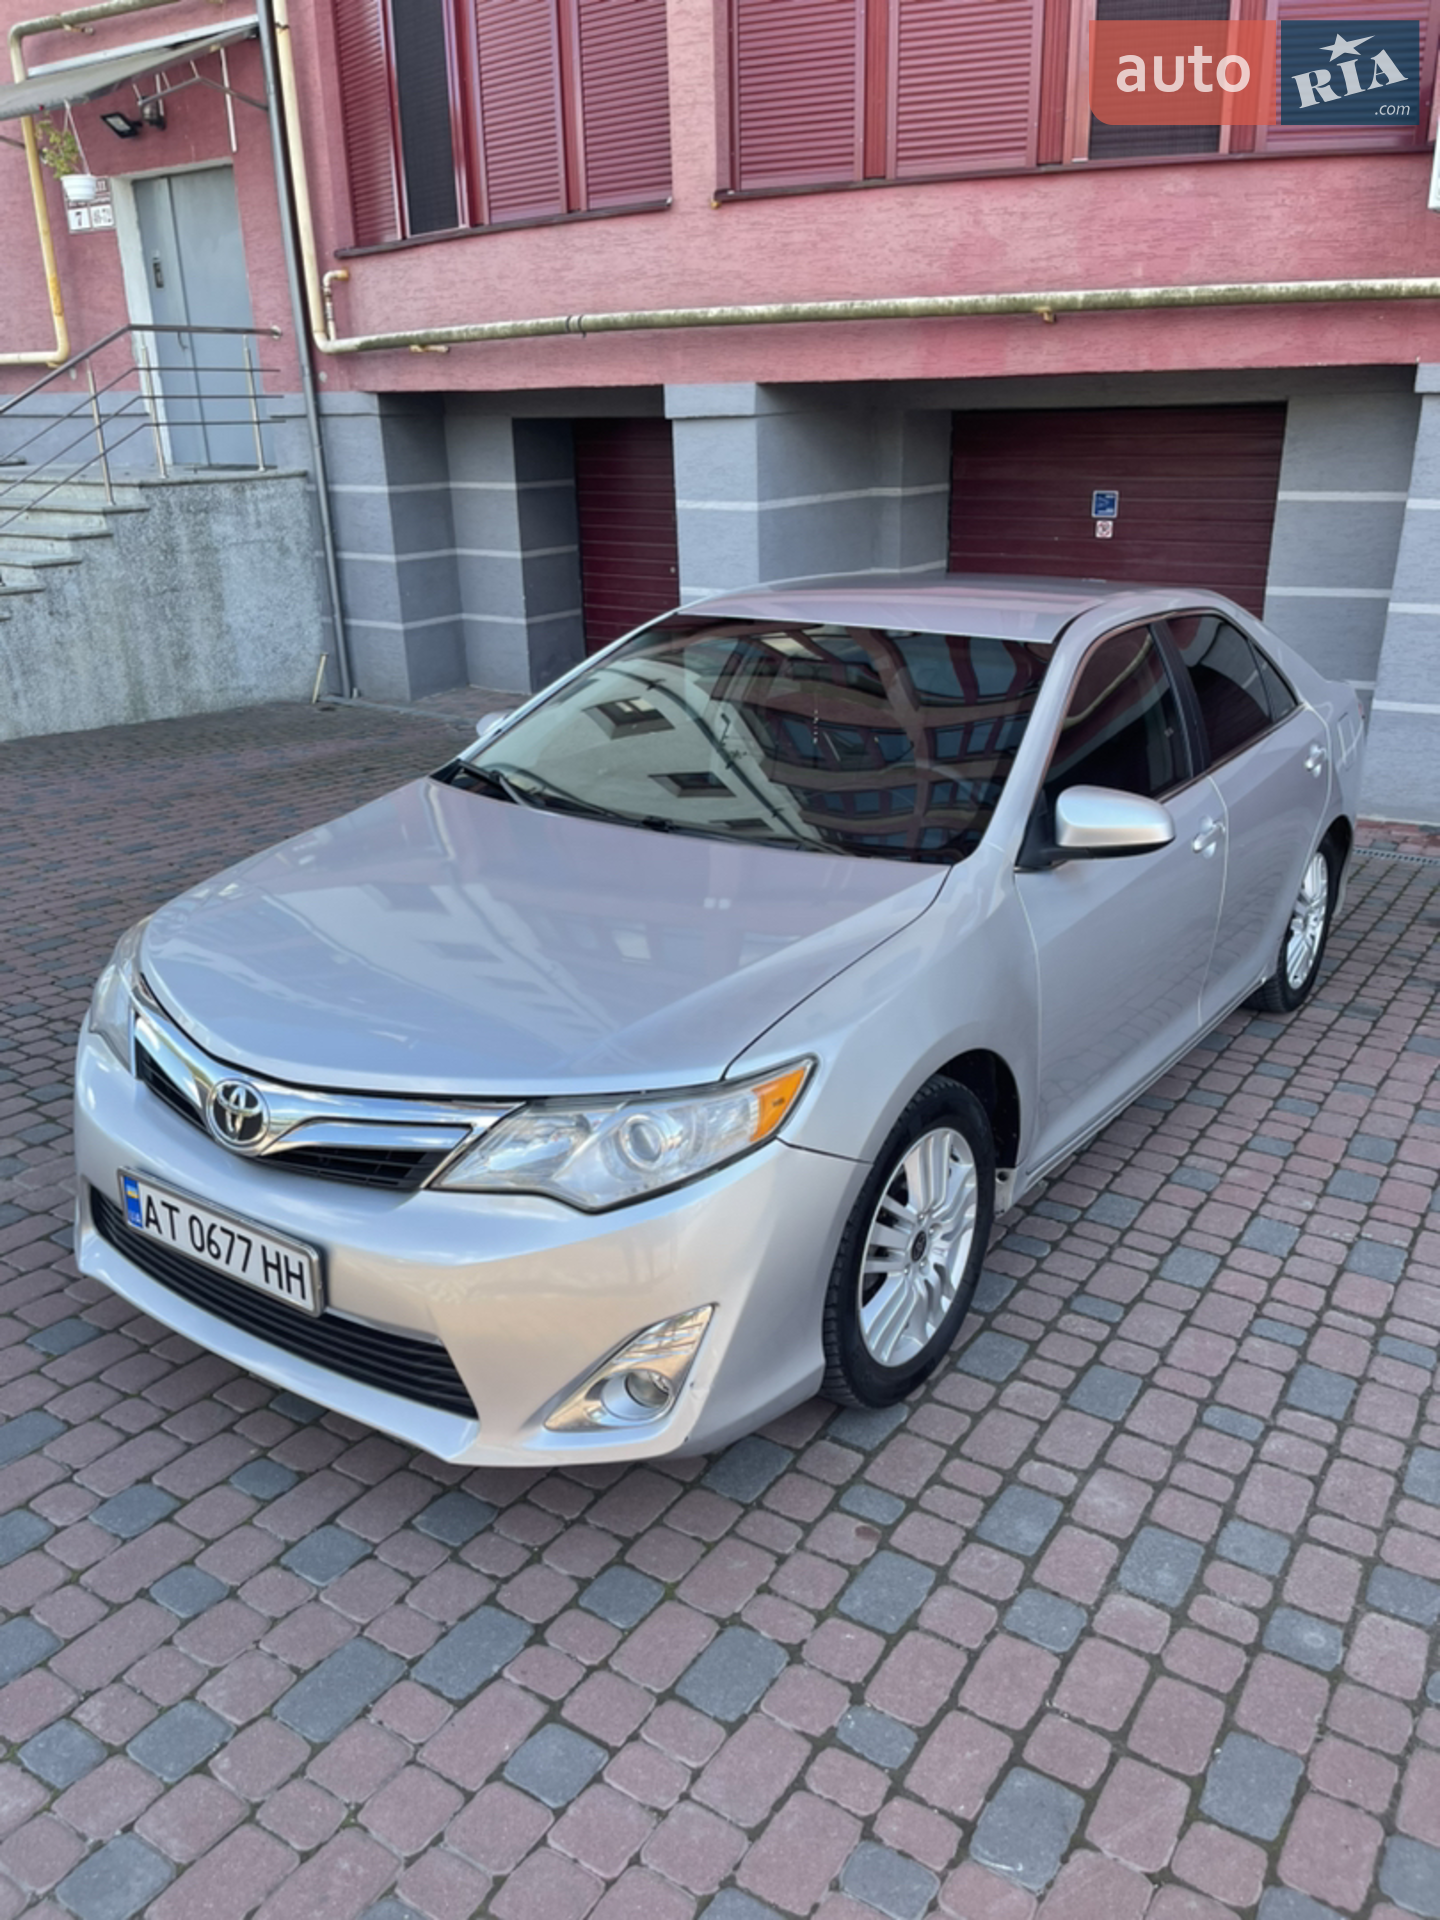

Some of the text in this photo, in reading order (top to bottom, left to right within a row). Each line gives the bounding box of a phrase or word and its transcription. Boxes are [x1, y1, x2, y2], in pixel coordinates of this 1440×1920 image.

[145, 1194, 306, 1300] AT 0677 HH
